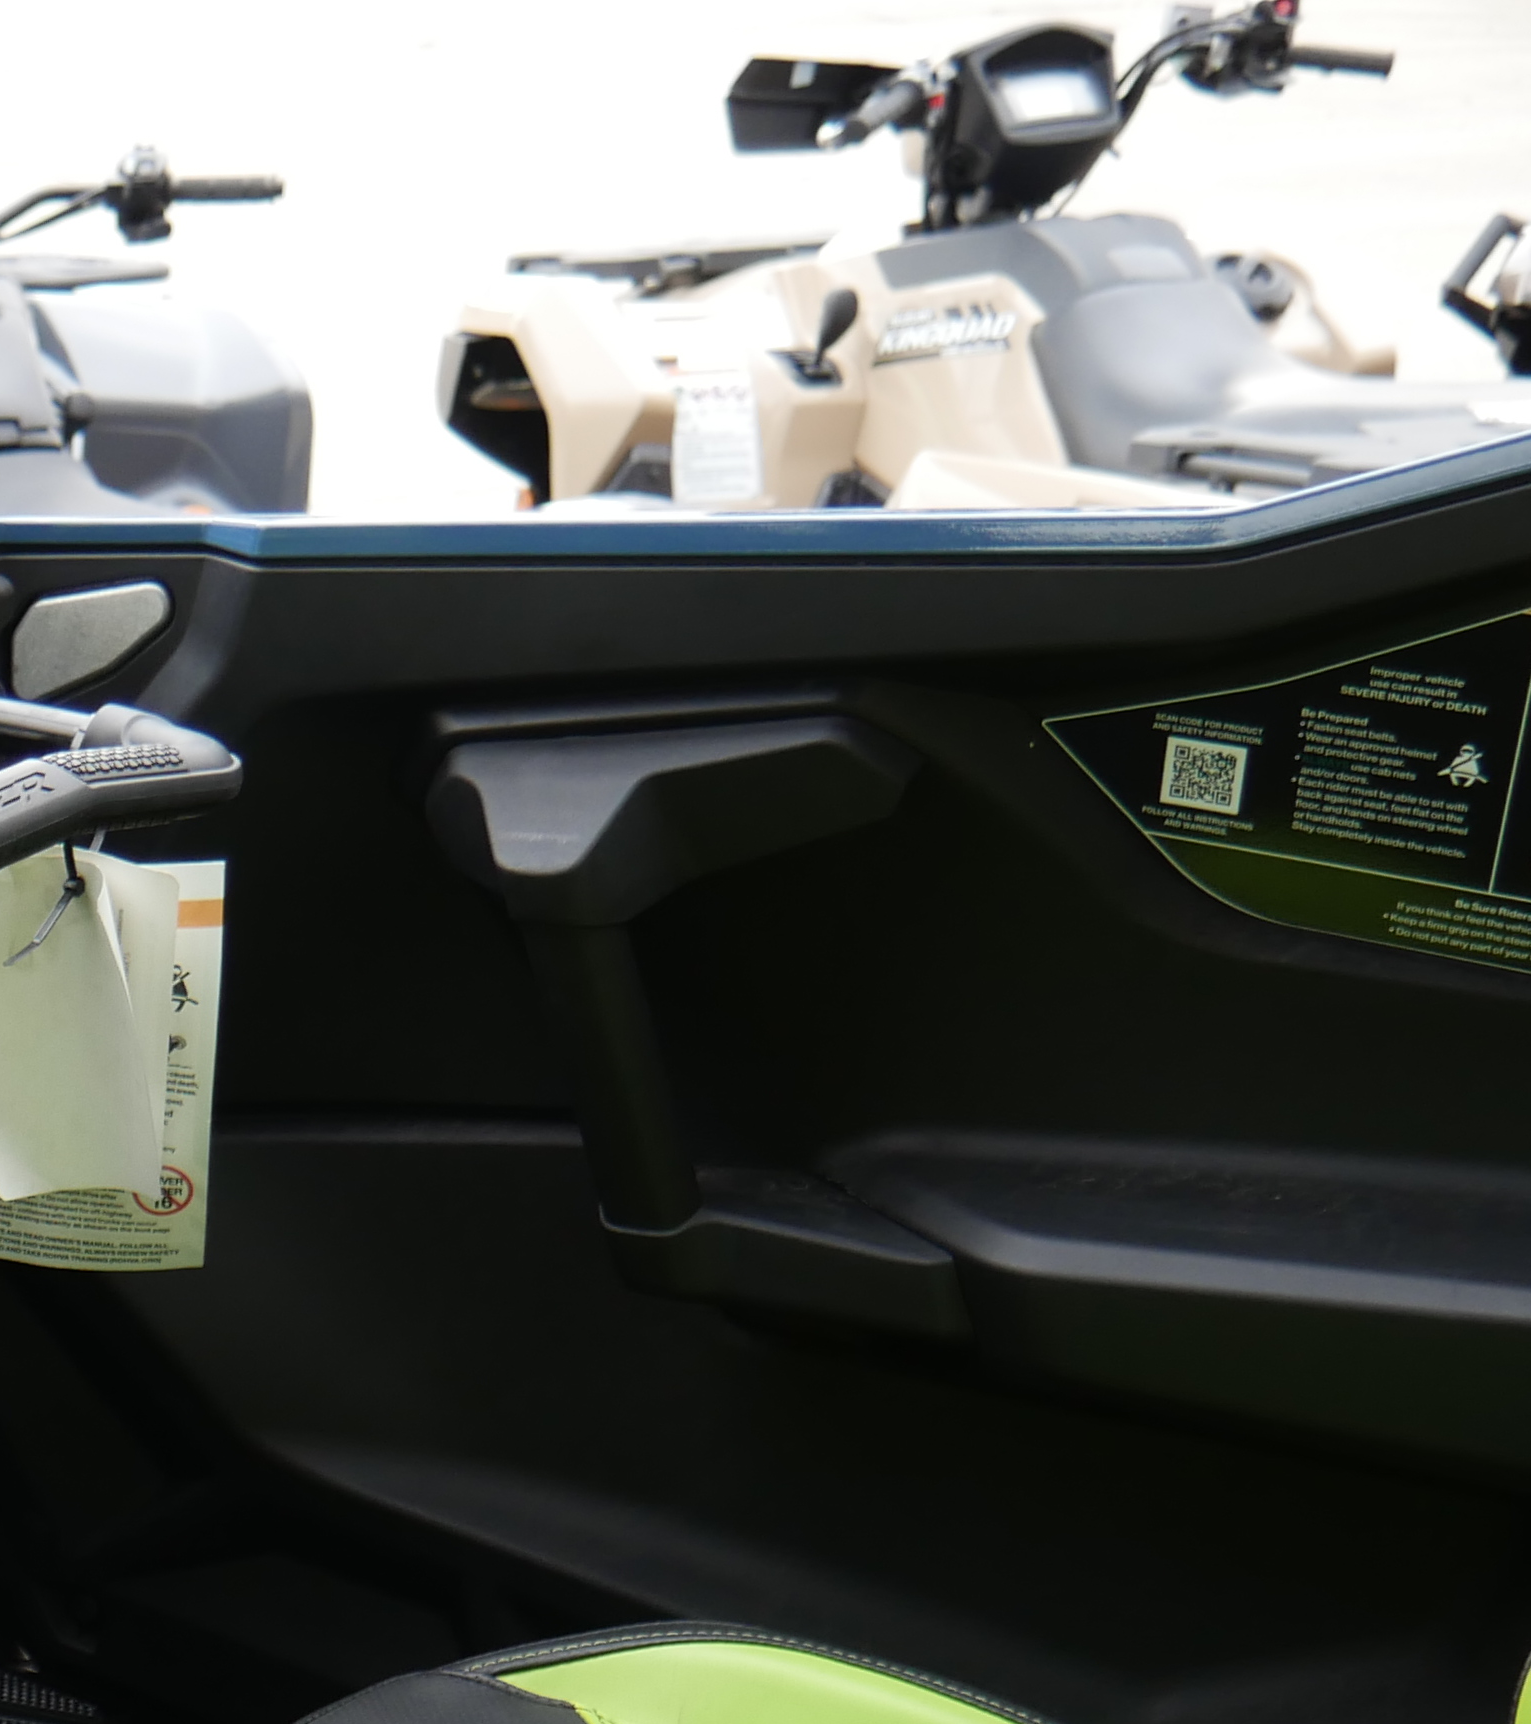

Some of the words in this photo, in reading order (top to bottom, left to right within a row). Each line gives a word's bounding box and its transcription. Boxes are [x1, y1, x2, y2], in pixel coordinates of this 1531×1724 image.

[1370, 666, 1421, 681] Improper
[1425, 676, 1465, 688] vehicle
[1370, 680, 1389, 689] use
[1391, 682, 1411, 692] can
[1413, 686, 1445, 697] result
[1447, 689, 1458, 699] in
[1340, 685, 1386, 701] SEVERE
[1387, 692, 1431, 707] INJURY
[1432, 700, 1444, 709] or
[1446, 701, 1487, 716] DEATH
[1155, 713, 1178, 722] SCAN
[1179, 717, 1203, 727] CODE
[1204, 720, 1222, 729] FOR
[1223, 723, 1263, 735] PRODUCT
[1301, 708, 1316, 718] Be
[1318, 710, 1369, 727] Prepared
[1152, 722, 1170, 731] AND
[1172, 725, 1203, 735] SAFETY
[1307, 721, 1342, 734] Fasten
[1344, 728, 1367, 738] seat
[1304, 745, 1324, 754] and
[1325, 748, 1378, 763] protective
[1305, 732, 1333, 744] Wear
[1333, 737, 1347, 746] an
[1348, 739, 1399, 755] approved
[1400, 748, 1438, 761] helmet
[1300, 766, 1335, 779] and/or
[1350, 763, 1370, 773] use
[1371, 766, 1391, 777] cab
[1393, 770, 1416, 781] nets
[1298, 777, 1324, 789] Each
[1325, 782, 1350, 792] rider
[1351, 786, 1377, 797] must
[1379, 790, 1392, 800] be
[1394, 793, 1417, 804] able
[1418, 797, 1430, 806] to
[1431, 799, 1444, 809] sit
[1445, 802, 1468, 813] with
[1142, 805, 1176, 817] FOLLOW
[1177, 812, 1193, 820] ALL
[1293, 811, 1305, 820] or
[1297, 788, 1322, 800] back
[1323, 793, 1362, 806] against
[1390, 804, 1413, 815] feet
[1413, 807, 1429, 817] flat
[1431, 811, 1444, 820] on
[1446, 813, 1464, 824] the
[1164, 819, 1181, 827] AND
[1322, 804, 1342, 815] and
[1343, 807, 1376, 820] hands
[1377, 813, 1391, 822] on
[1392, 816, 1435, 832] steering
[1436, 823, 1468, 836] wheel
[1292, 820, 1316, 834] Stay
[1316, 826, 1373, 844] completely
[1374, 835, 1405, 848] inside
[1407, 840, 1424, 851] the
[1397, 901, 1405, 910] If
[1405, 905, 1425, 914] you
[1426, 907, 1452, 919] think
[1453, 913, 1464, 921] or
[1466, 915, 1486, 926] feel
[1487, 919, 1504, 929] the
[1455, 899, 1470, 910] Be
[1471, 902, 1497, 915] Sure
[1390, 913, 1417, 926] Keep
[1427, 920, 1447, 931] firm
[1448, 925, 1469, 936] grip
[1470, 930, 1484, 938] on
[1486, 932, 1503, 942] the
[1395, 927, 1411, 938] Do
[1412, 931, 1429, 941] not
[1430, 935, 1448, 945] put
[1450, 938, 1468, 950] any
[1470, 943, 1492, 954] part
[1493, 946, 1504, 955] of
[1505, 950, 1529, 960] your
